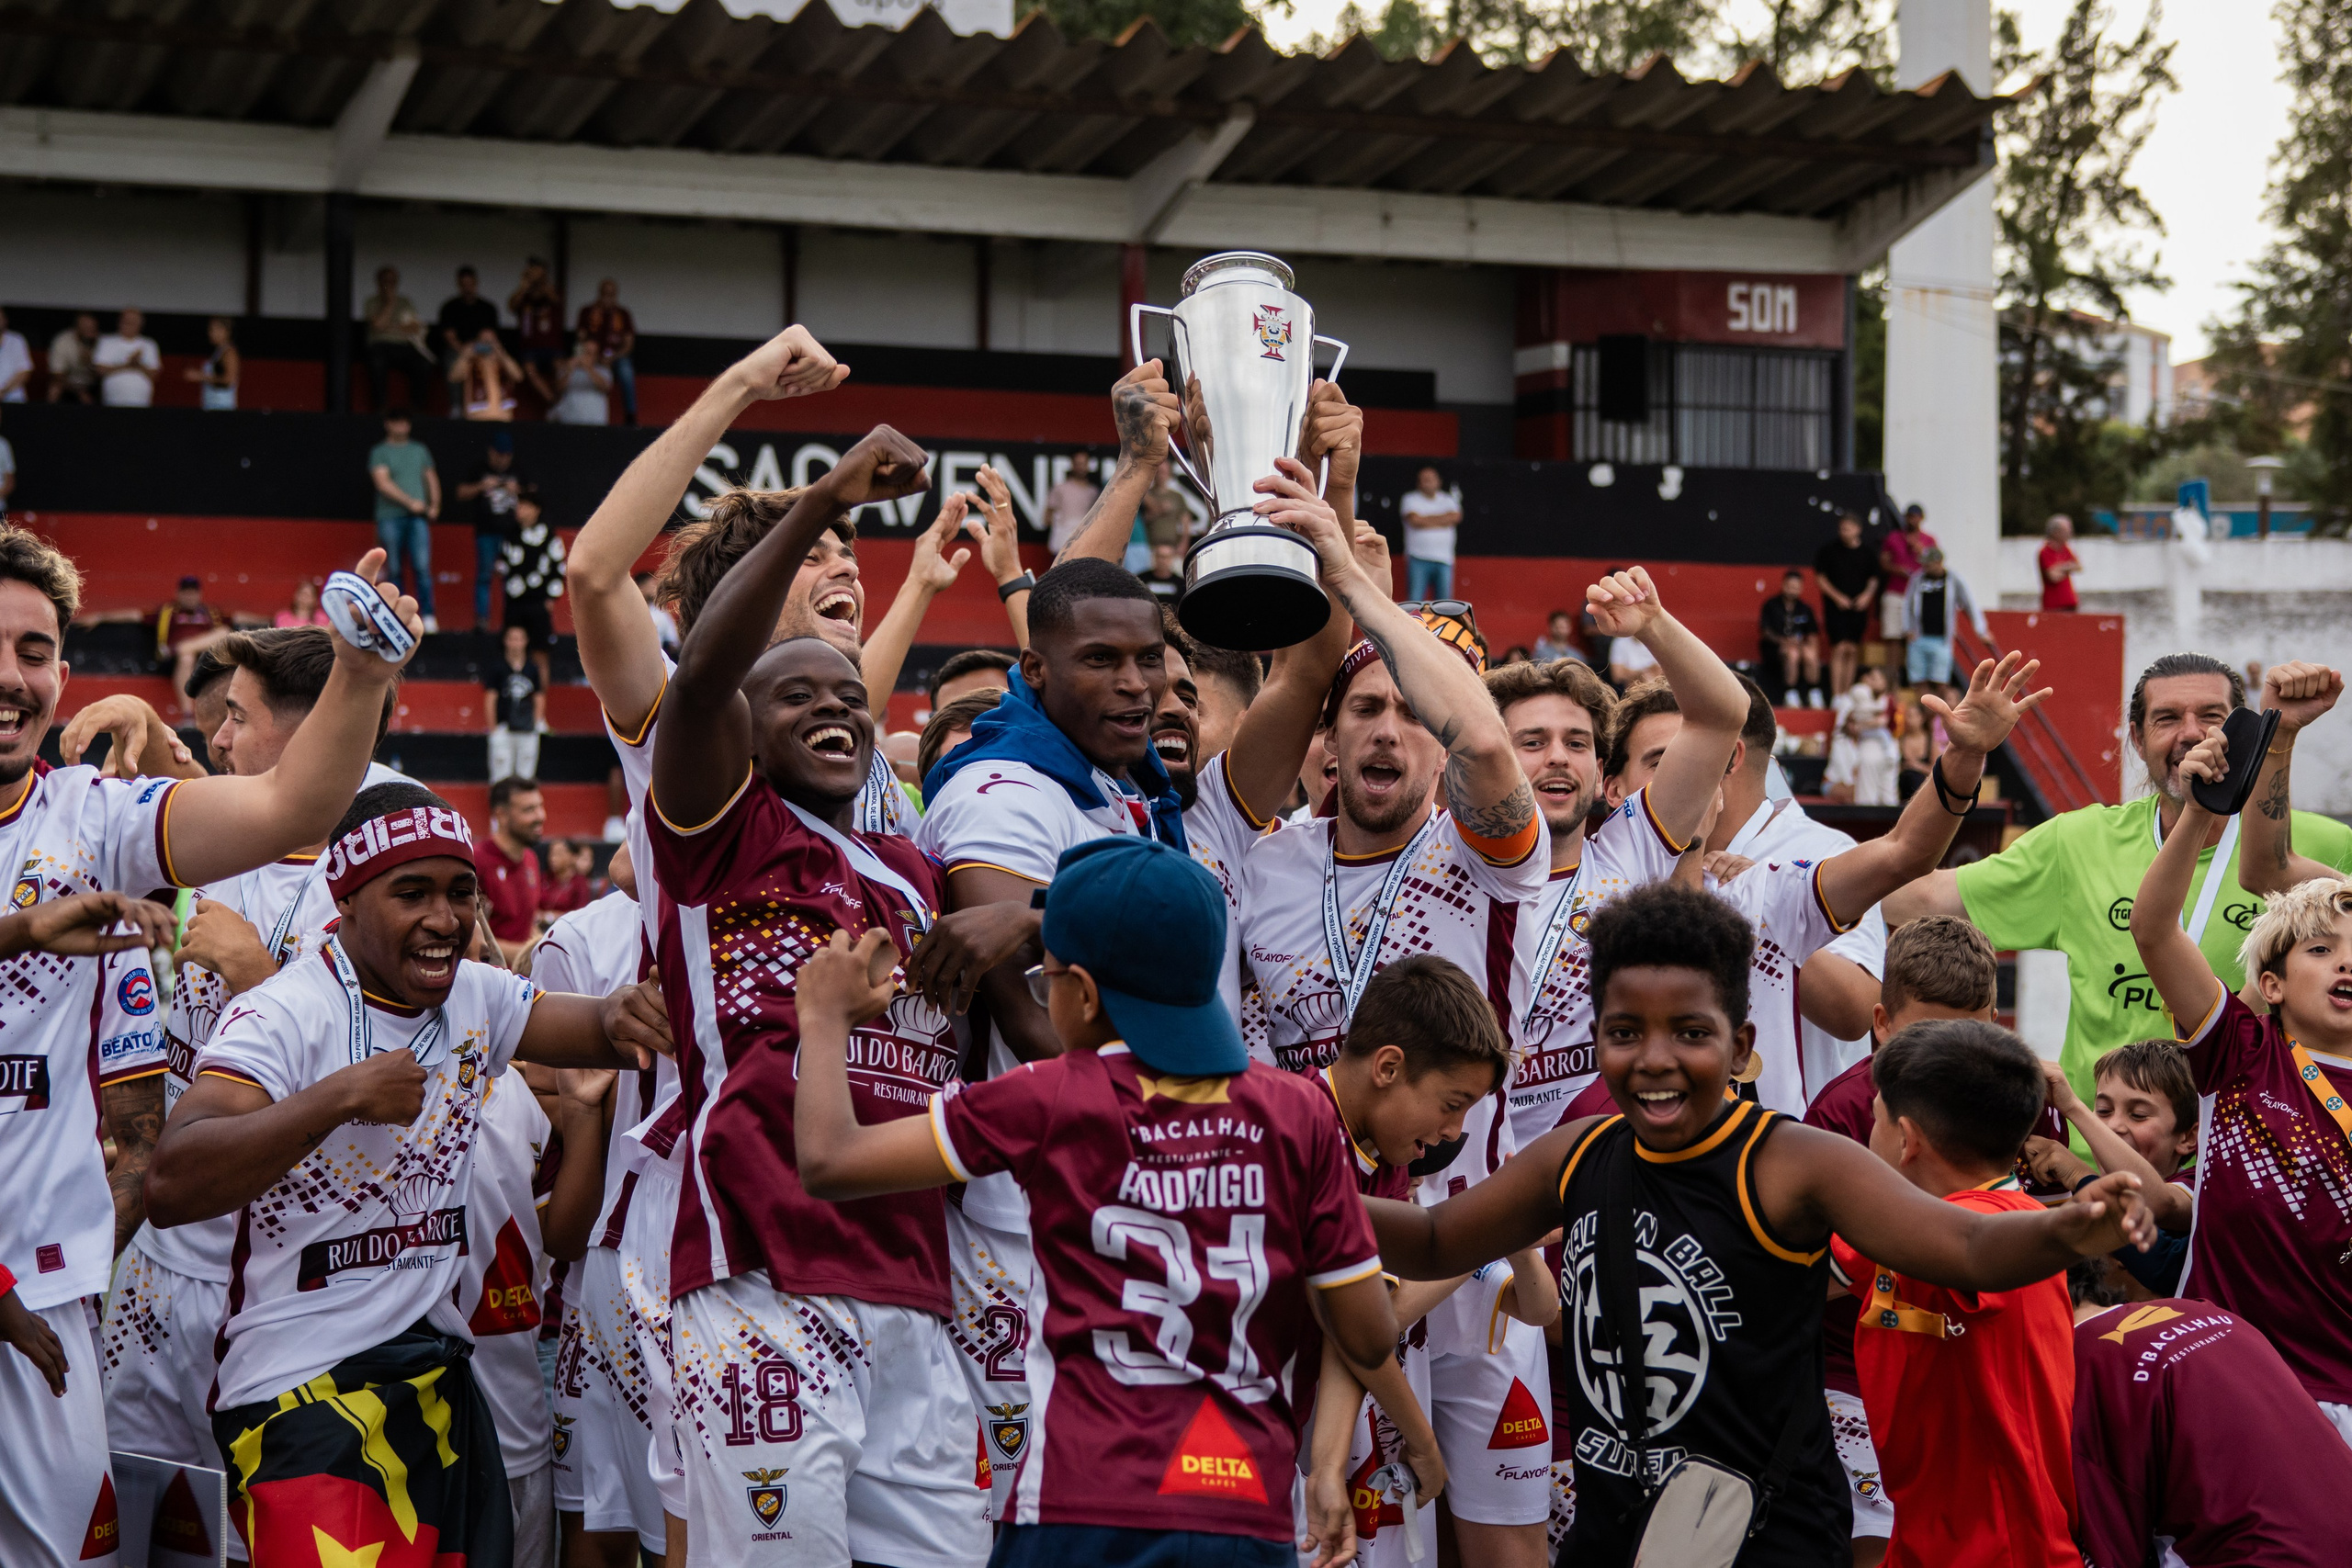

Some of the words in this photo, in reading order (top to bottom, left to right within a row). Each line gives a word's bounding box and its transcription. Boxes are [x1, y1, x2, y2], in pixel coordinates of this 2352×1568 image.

[1727, 282, 1797, 333] SOM
[870, 807, 876, 815] DE
[1384, 883, 1395, 901] LISBOA
[1329, 912, 1338, 938] FUTEBOL
[1366, 922, 1381, 959] ASSOCIAÇÃO
[1541, 935, 1555, 964] ASSOCIAÇÃO
[1332, 939, 1345, 973] ASSOCIAÇÃO
[1360, 958, 1370, 983] FUTEBOL
[1356, 983, 1362, 992] DE
[355, 1016, 360, 1024] DE
[101, 1032, 152, 1057] BEATO
[868, 1038, 898, 1069] DO
[2261, 1098, 2300, 1118] PLAYOFF
[1148, 1148, 1231, 1164] RESTAURANTE
[1117, 1161, 1265, 1213] RODRIGO
[328, 1238, 363, 1270] RUI
[368, 1233, 401, 1262] DO
[1663, 1234, 1743, 1342] BALL
[1091, 1205, 1277, 1404] 31
[2132, 1314, 2233, 1382] D'BACALHAU
[2168, 1330, 2226, 1363] RESTAURANTE
[722, 1359, 803, 1447] 18
[1503, 1416, 1543, 1435] DELTA
[1182, 1454, 1253, 1480] DELTA
[752, 1531, 793, 1541] ORIENTAL
